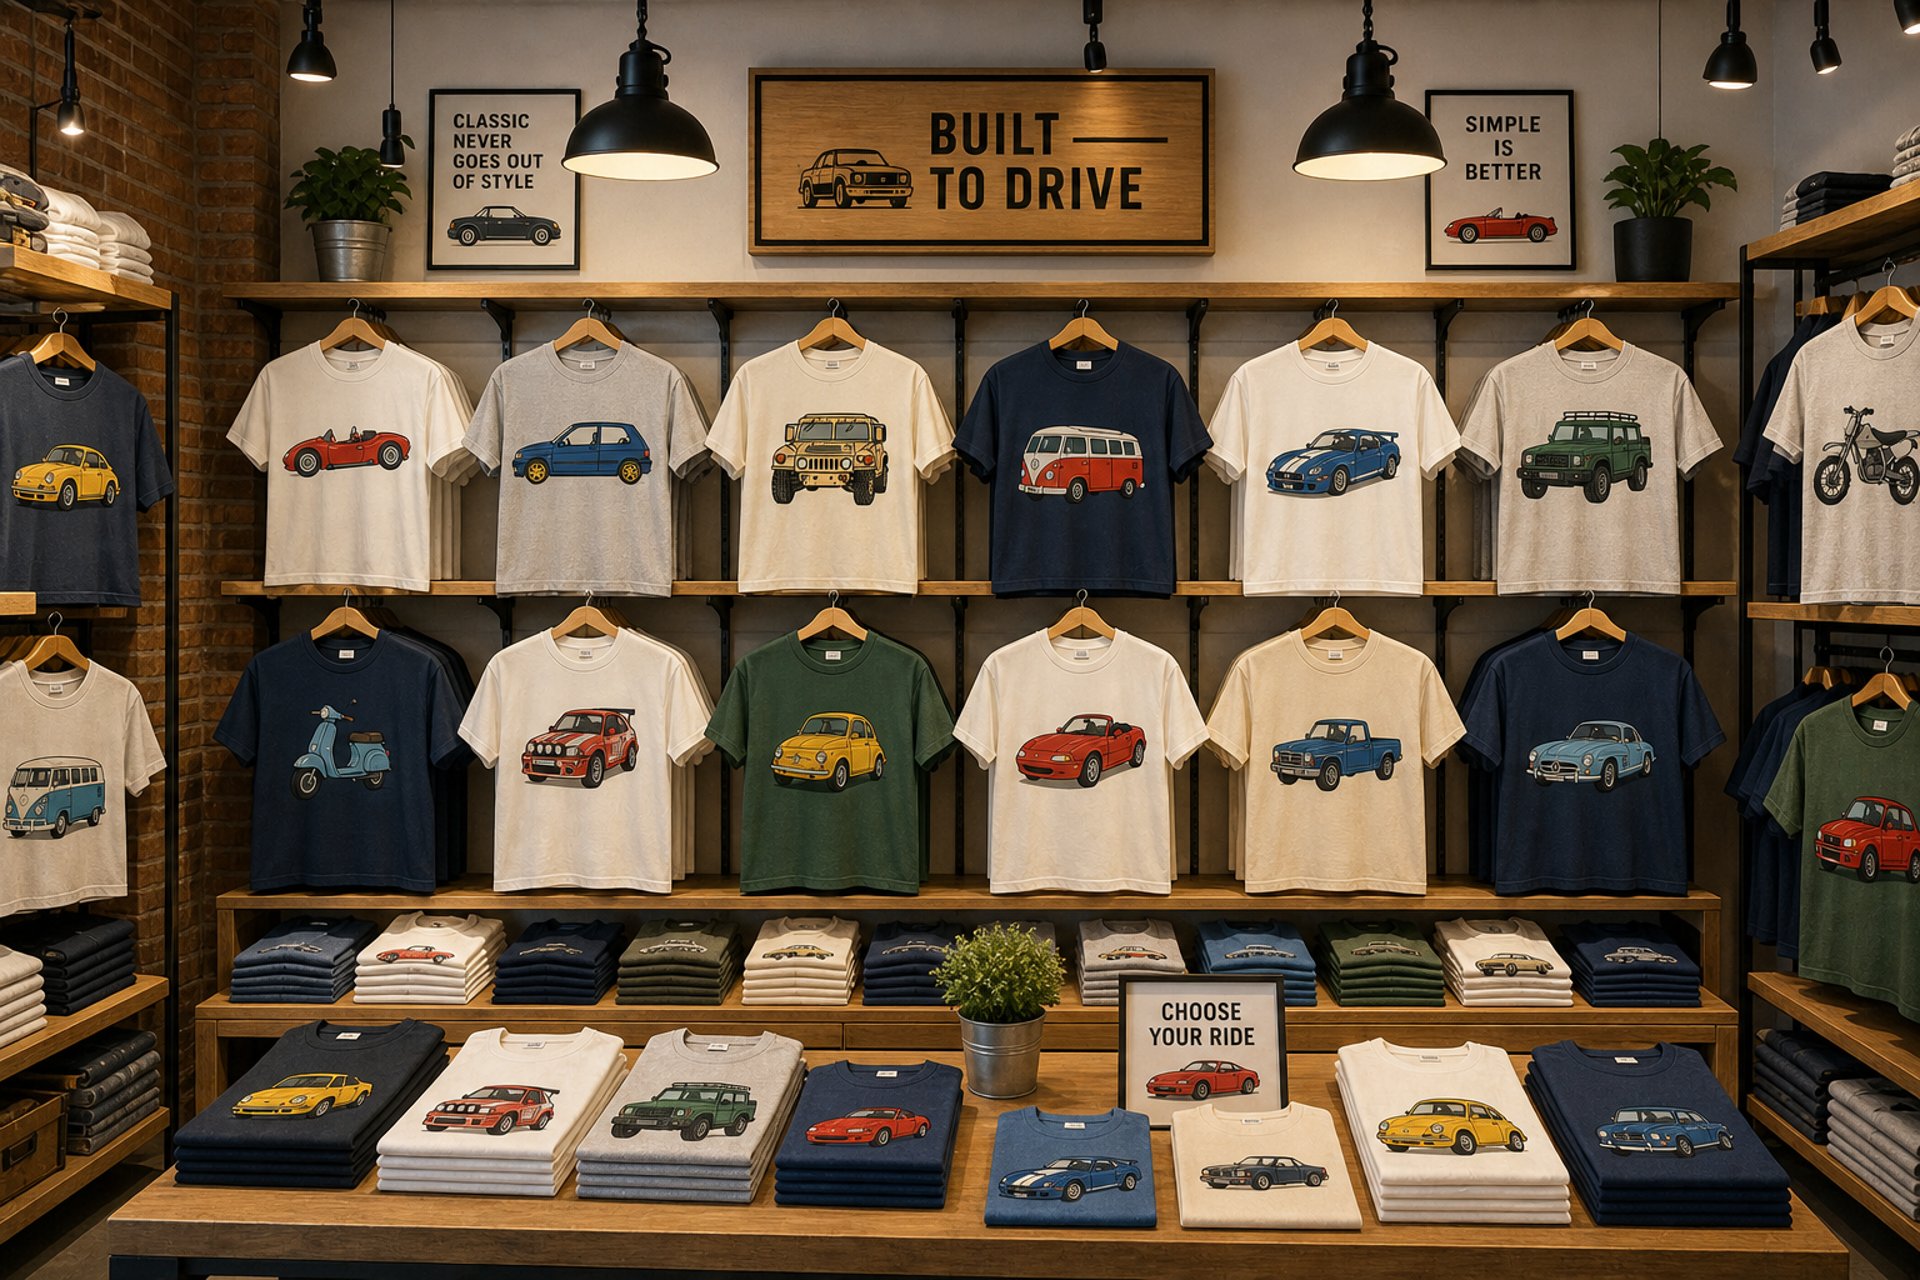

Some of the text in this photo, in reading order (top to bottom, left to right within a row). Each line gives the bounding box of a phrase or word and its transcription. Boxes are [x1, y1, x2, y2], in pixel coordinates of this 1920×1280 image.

[453, 113, 530, 129] CLASSIC
[1465, 115, 1541, 133] SIMPLE
[453, 133, 512, 149] NEVER
[930, 111, 1060, 156] BUILT
[1494, 139, 1514, 157] IS
[452, 153, 544, 169] GOES OUT
[1465, 162, 1542, 181] BETTER
[452, 173, 534, 190] OF STYLE
[929, 166, 1142, 211] TO DRIVE
[1161, 1002, 1242, 1021] CHOOSE
[1149, 1027, 1255, 1046] YOUR RIDE
